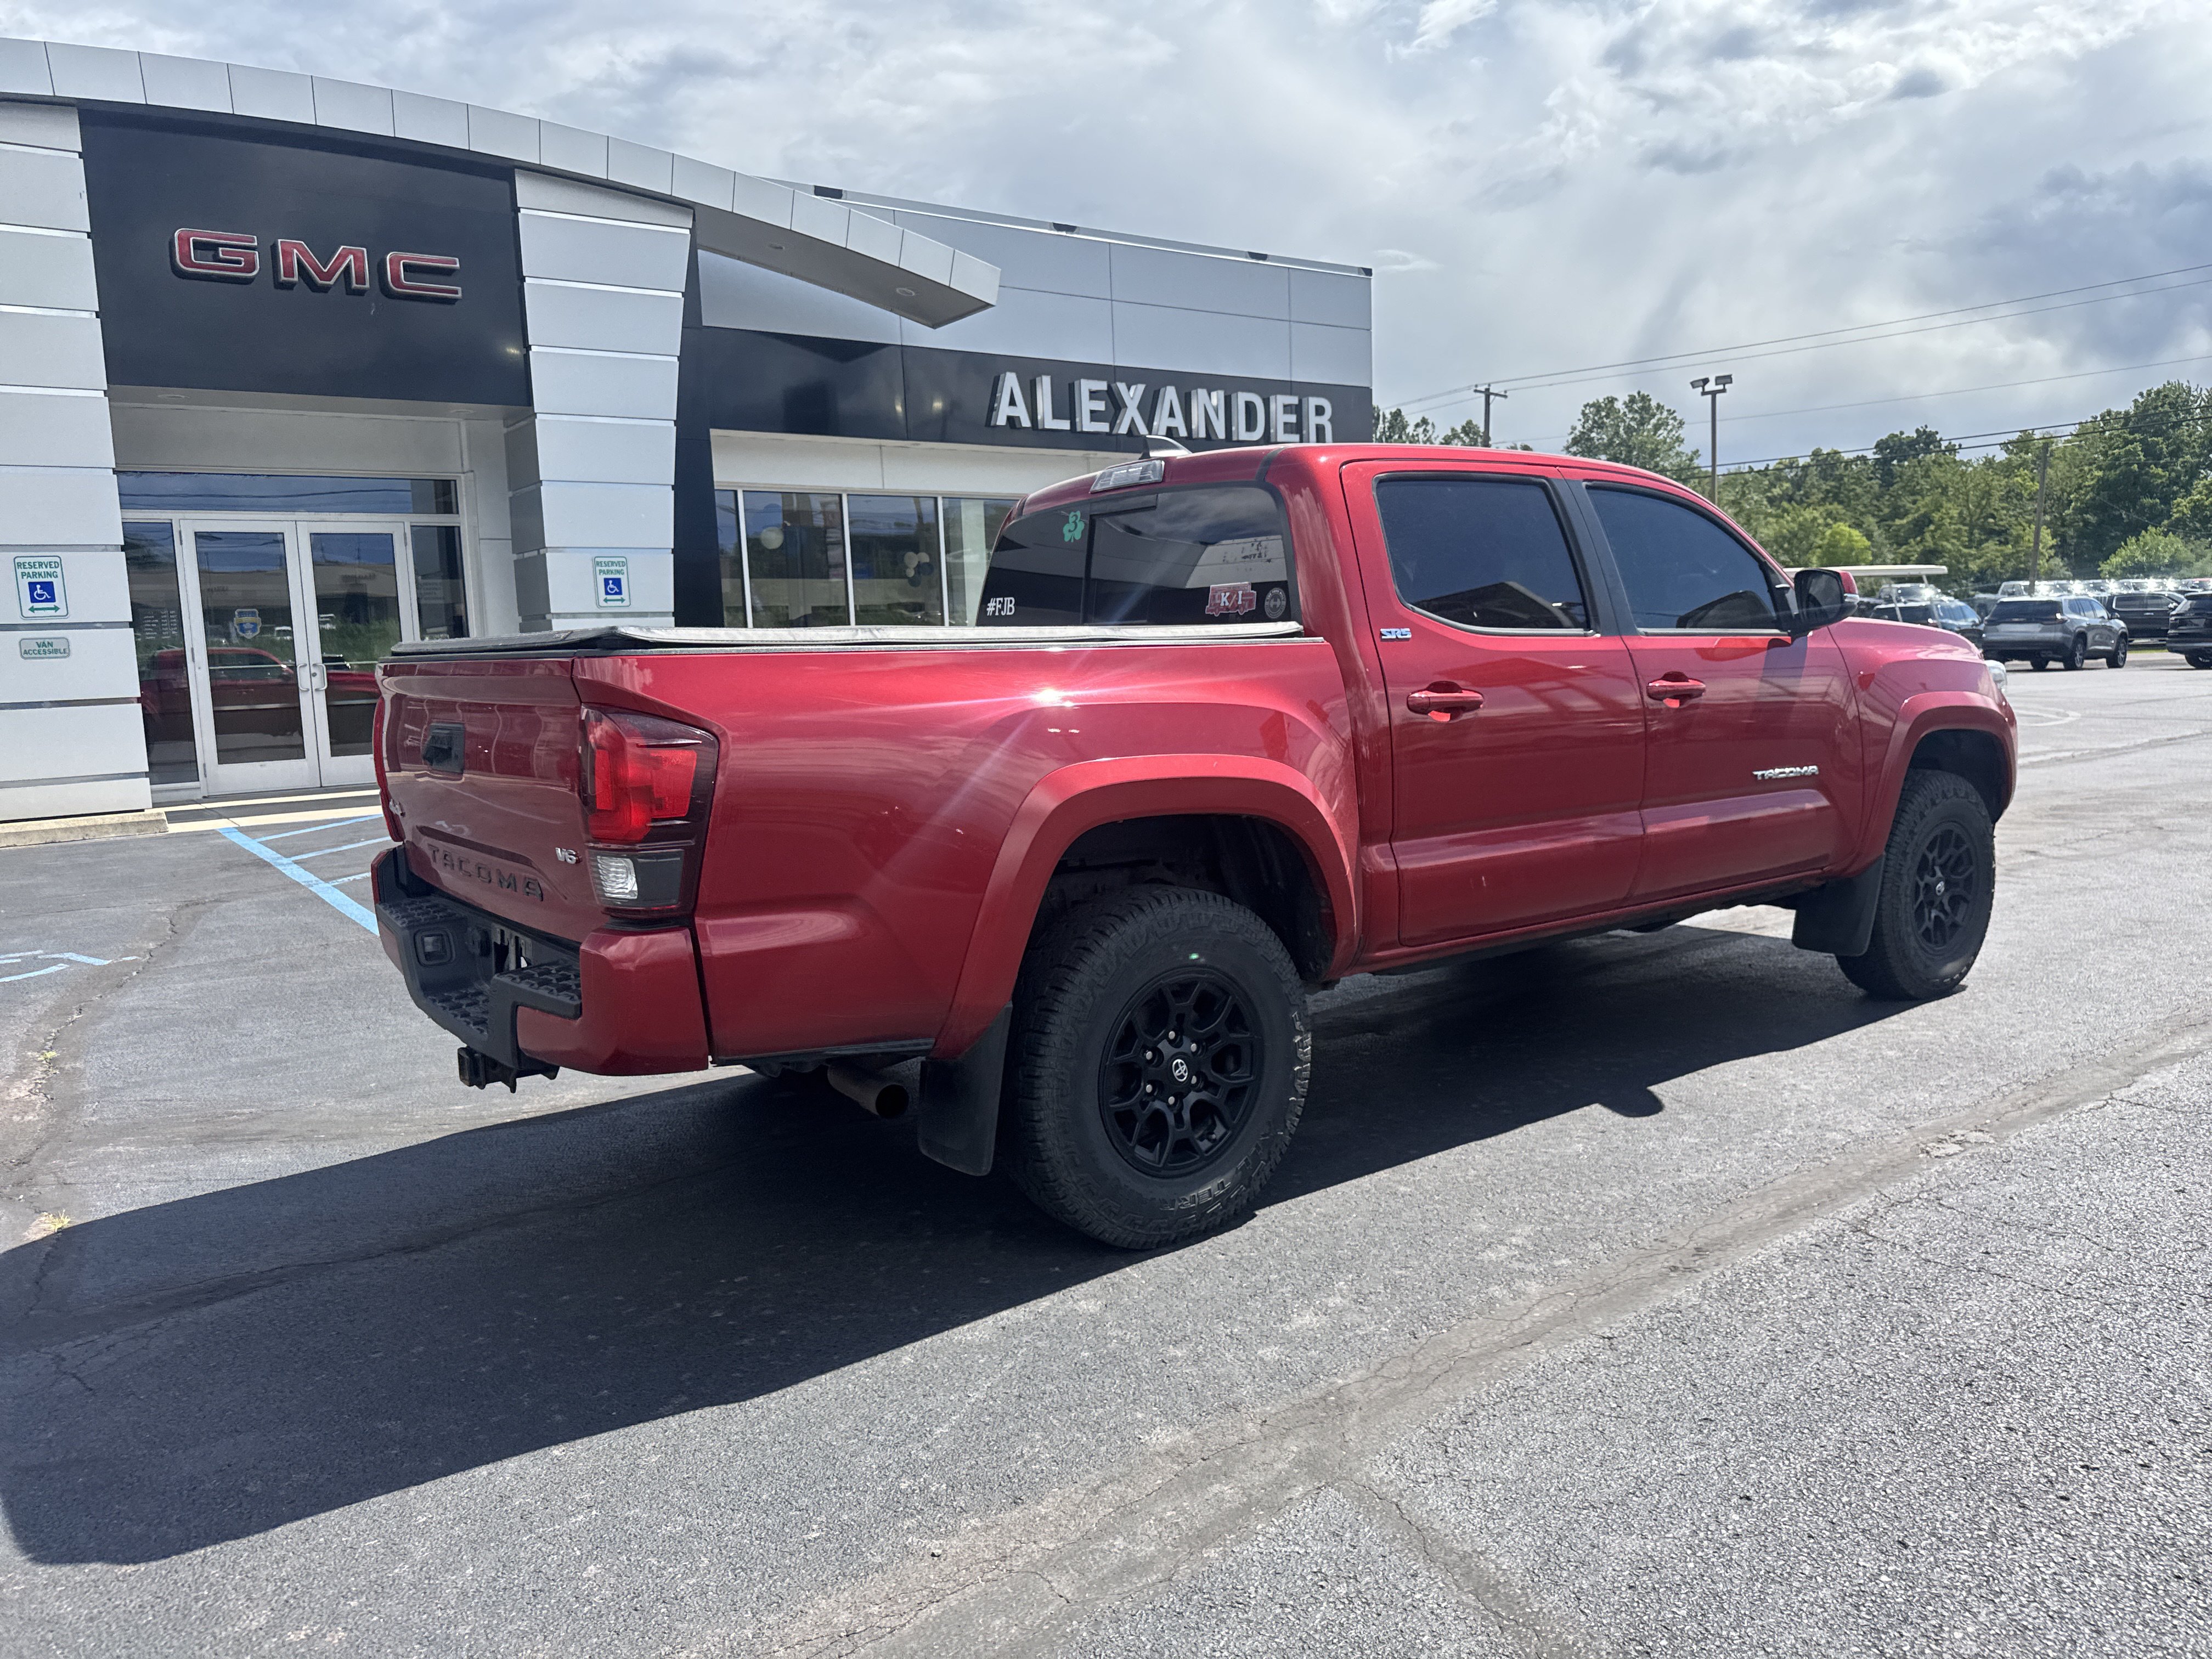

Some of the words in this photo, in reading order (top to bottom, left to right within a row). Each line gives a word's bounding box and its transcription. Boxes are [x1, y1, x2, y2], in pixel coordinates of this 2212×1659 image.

[173, 228, 462, 299] GMC
[991, 371, 1333, 444] ALEXANDER
[16, 561, 60, 569] RESERVED
[21, 571, 59, 579] PARKING
[986, 597, 1015, 616] #FJB
[1380, 628, 1412, 640] SR5
[1752, 765, 1819, 780] TACOMA
[555, 847, 577, 865] V6
[426, 842, 544, 902] TACOMA
